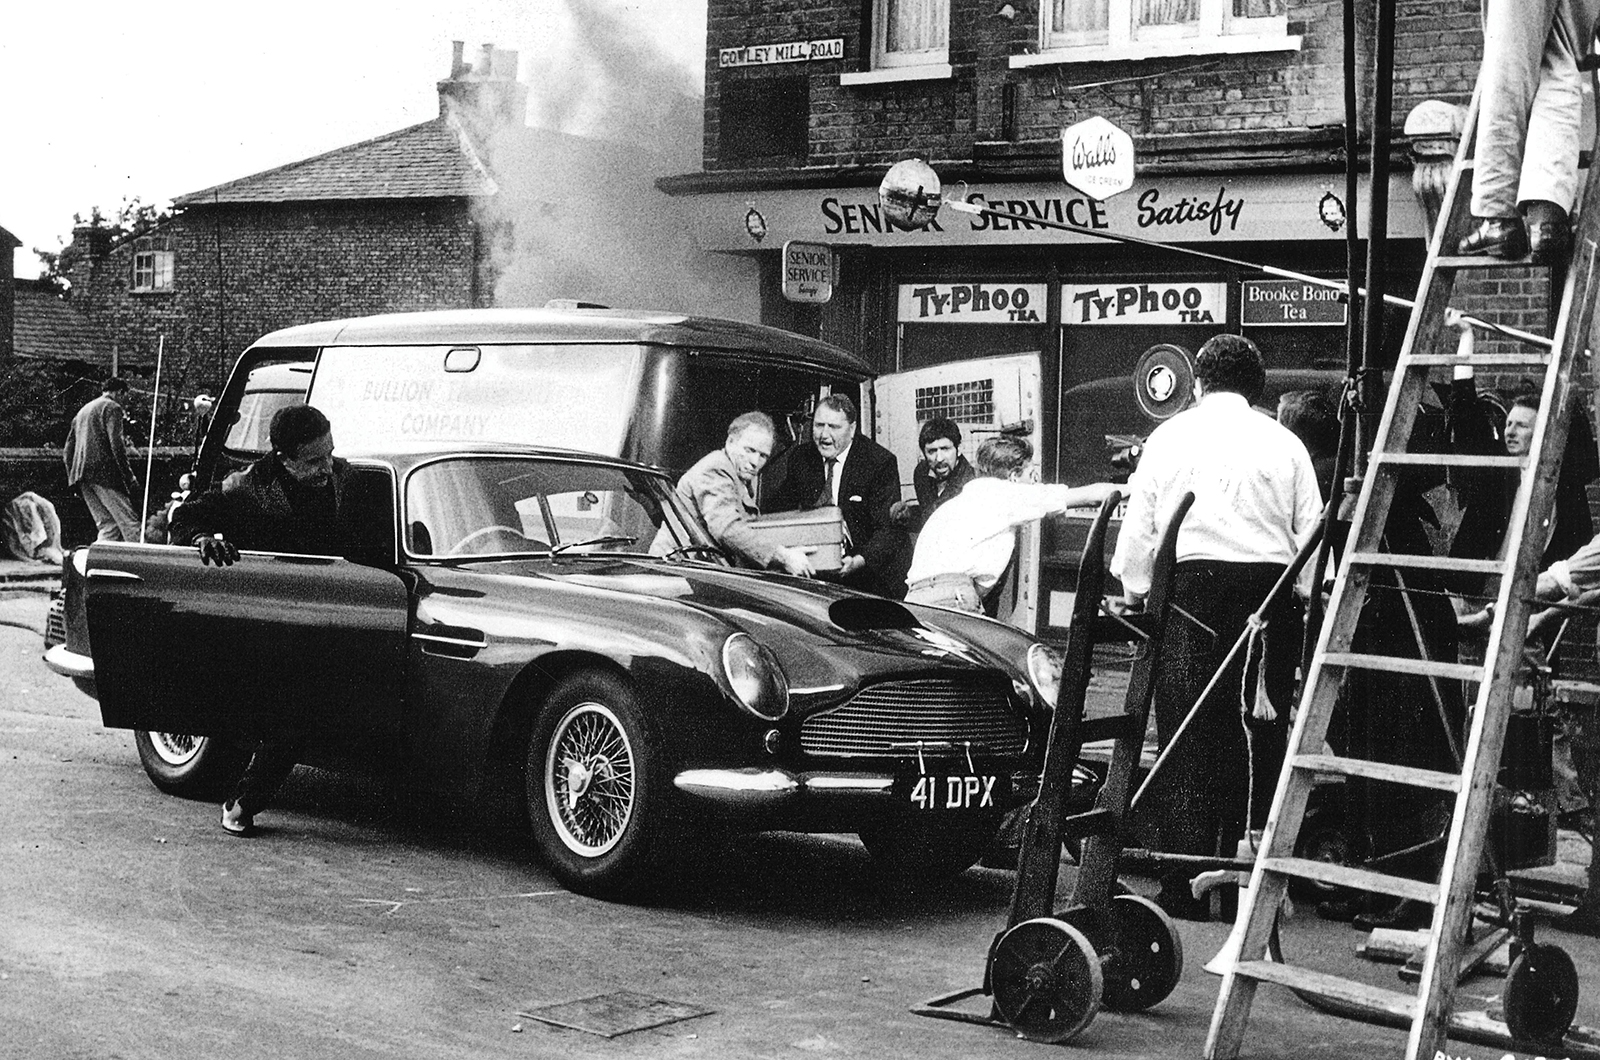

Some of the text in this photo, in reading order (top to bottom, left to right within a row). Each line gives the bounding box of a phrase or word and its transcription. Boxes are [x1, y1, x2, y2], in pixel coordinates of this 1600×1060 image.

[776, 44, 806, 60] MILL
[811, 41, 841, 57] ROAD
[966, 192, 1109, 231] SERVICE
[1137, 186, 1245, 236] Satisfy
[790, 251, 827, 266] SENIOR
[788, 267, 827, 283] SERVICE
[1248, 286, 1300, 302] Brooke
[1007, 309, 1040, 322] TEA
[1178, 310, 1214, 323] TEA
[1280, 303, 1308, 319] Tea
[362, 380, 434, 402] BULLION
[400, 413, 492, 436] COMPANY
[910, 775, 997, 810] 41 DPX
